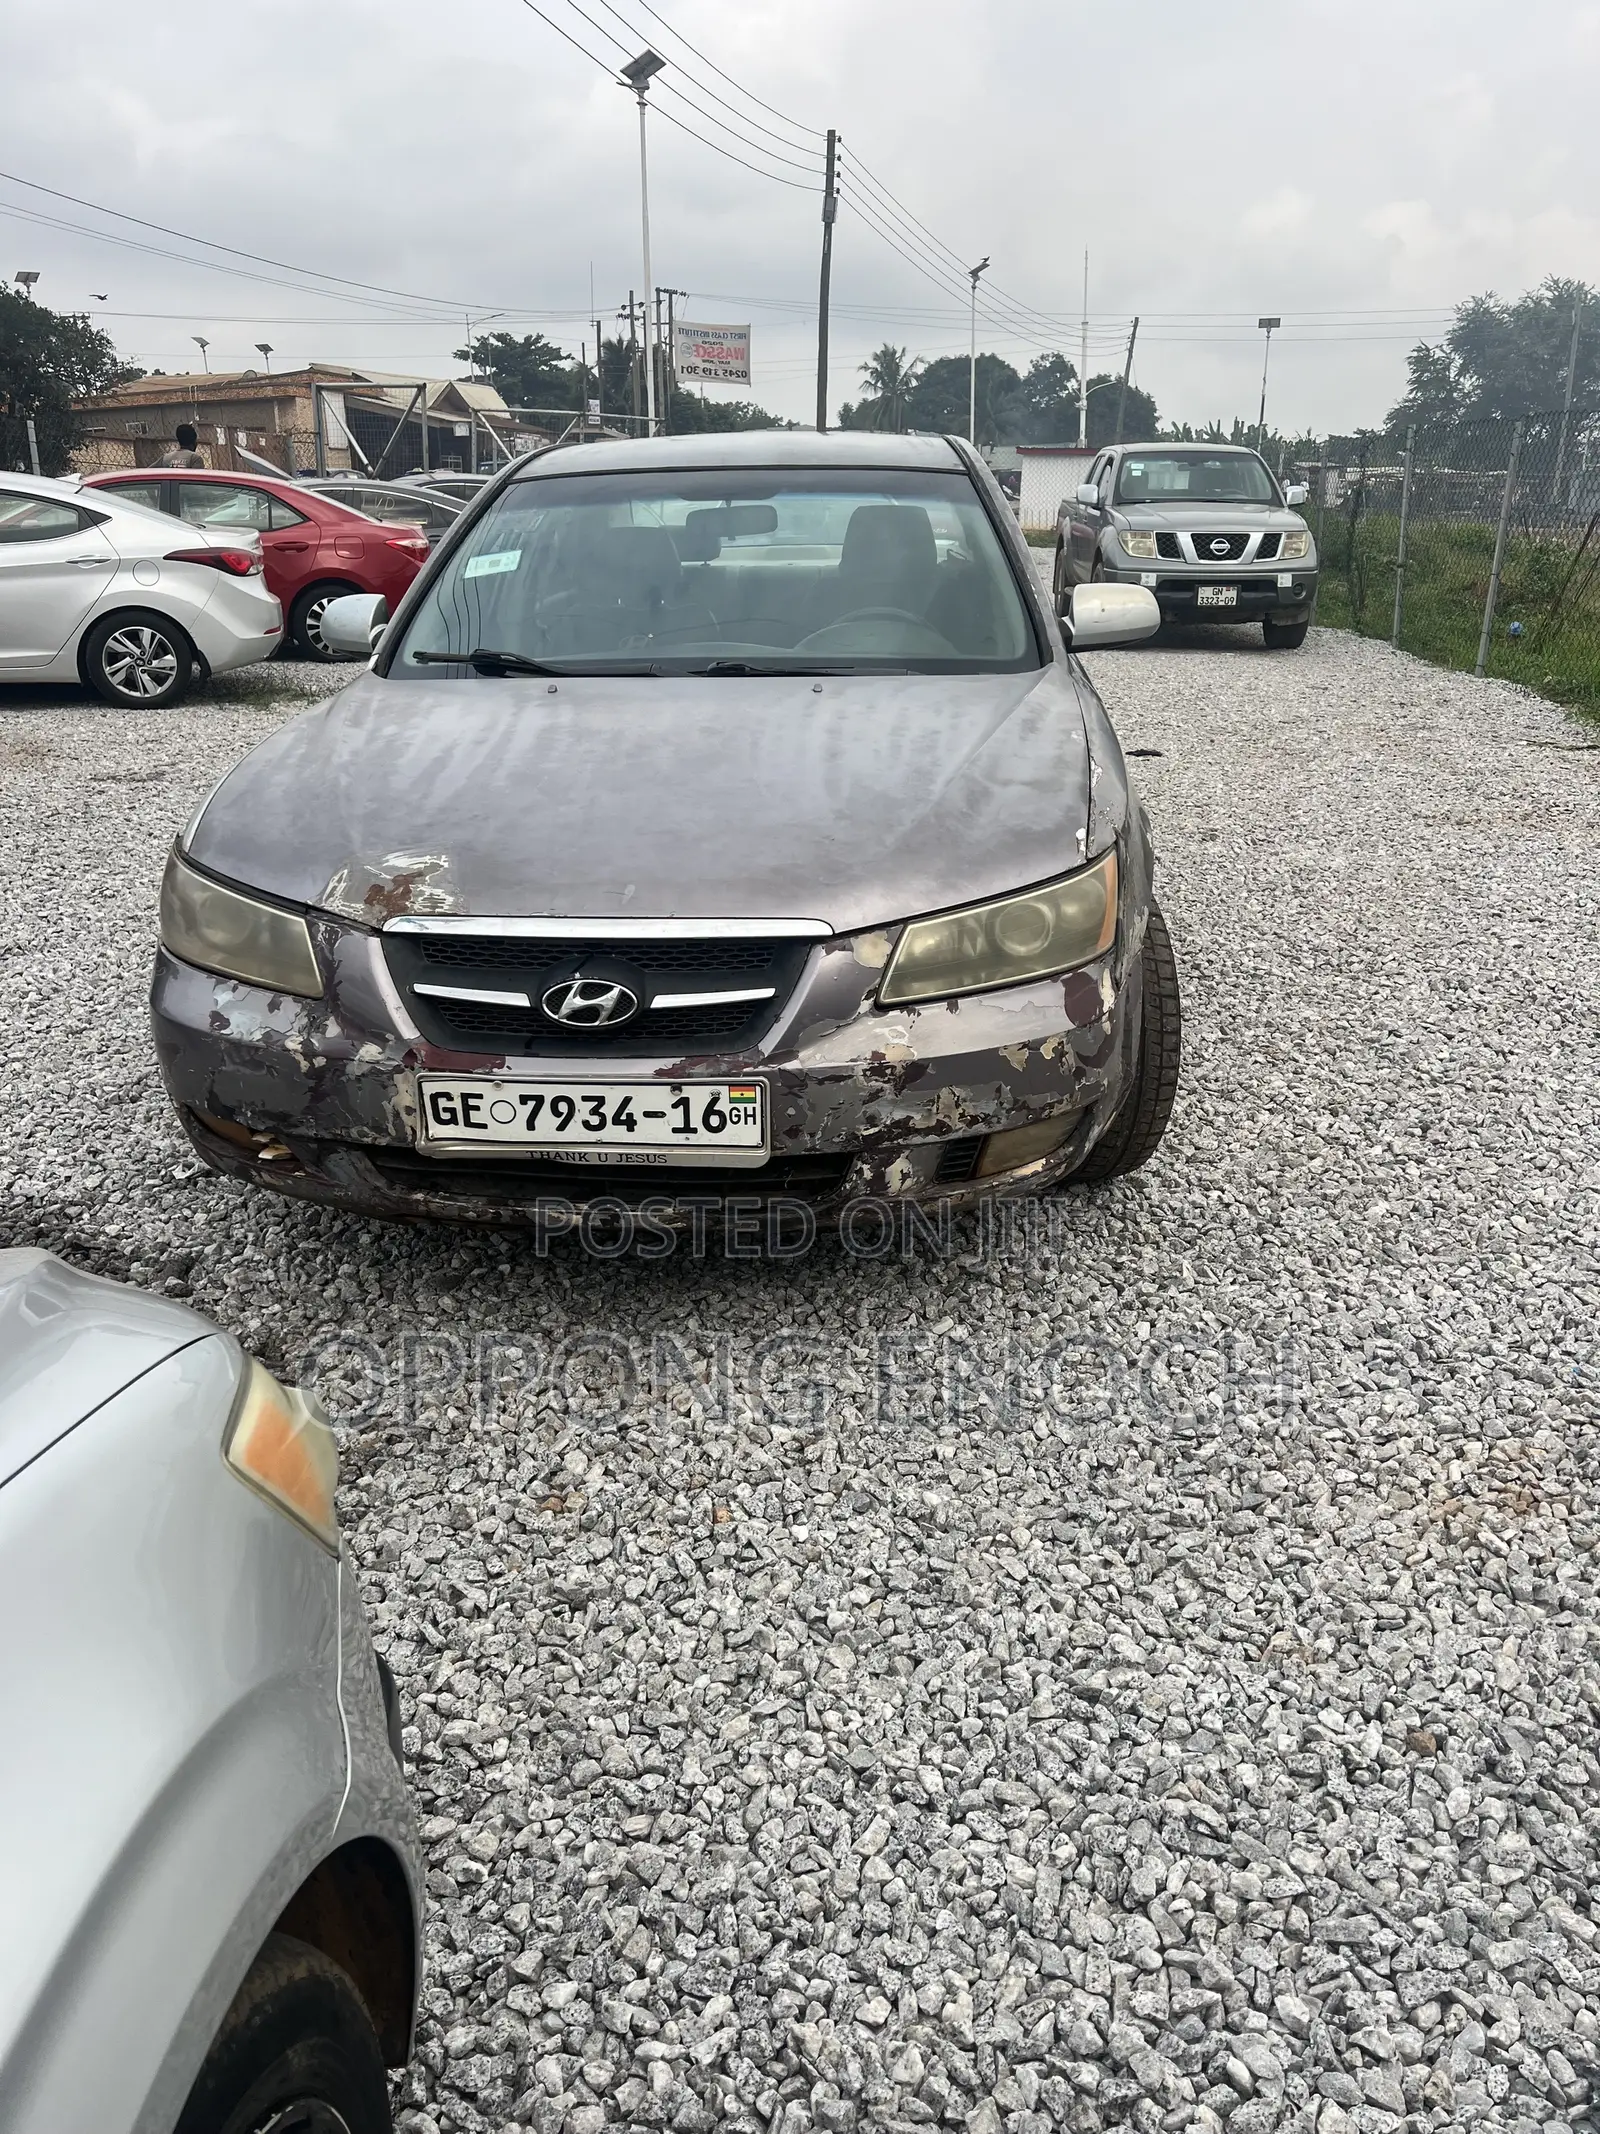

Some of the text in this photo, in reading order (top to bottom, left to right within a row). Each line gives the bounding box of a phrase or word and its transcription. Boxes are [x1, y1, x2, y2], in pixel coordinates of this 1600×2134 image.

[1212, 587, 1223, 595] GN
[1199, 596, 1235, 605] 3323-09
[429, 1091, 757, 1134] GE 7934-16 GH
[525, 1151, 668, 1164] THANK U JESUS
